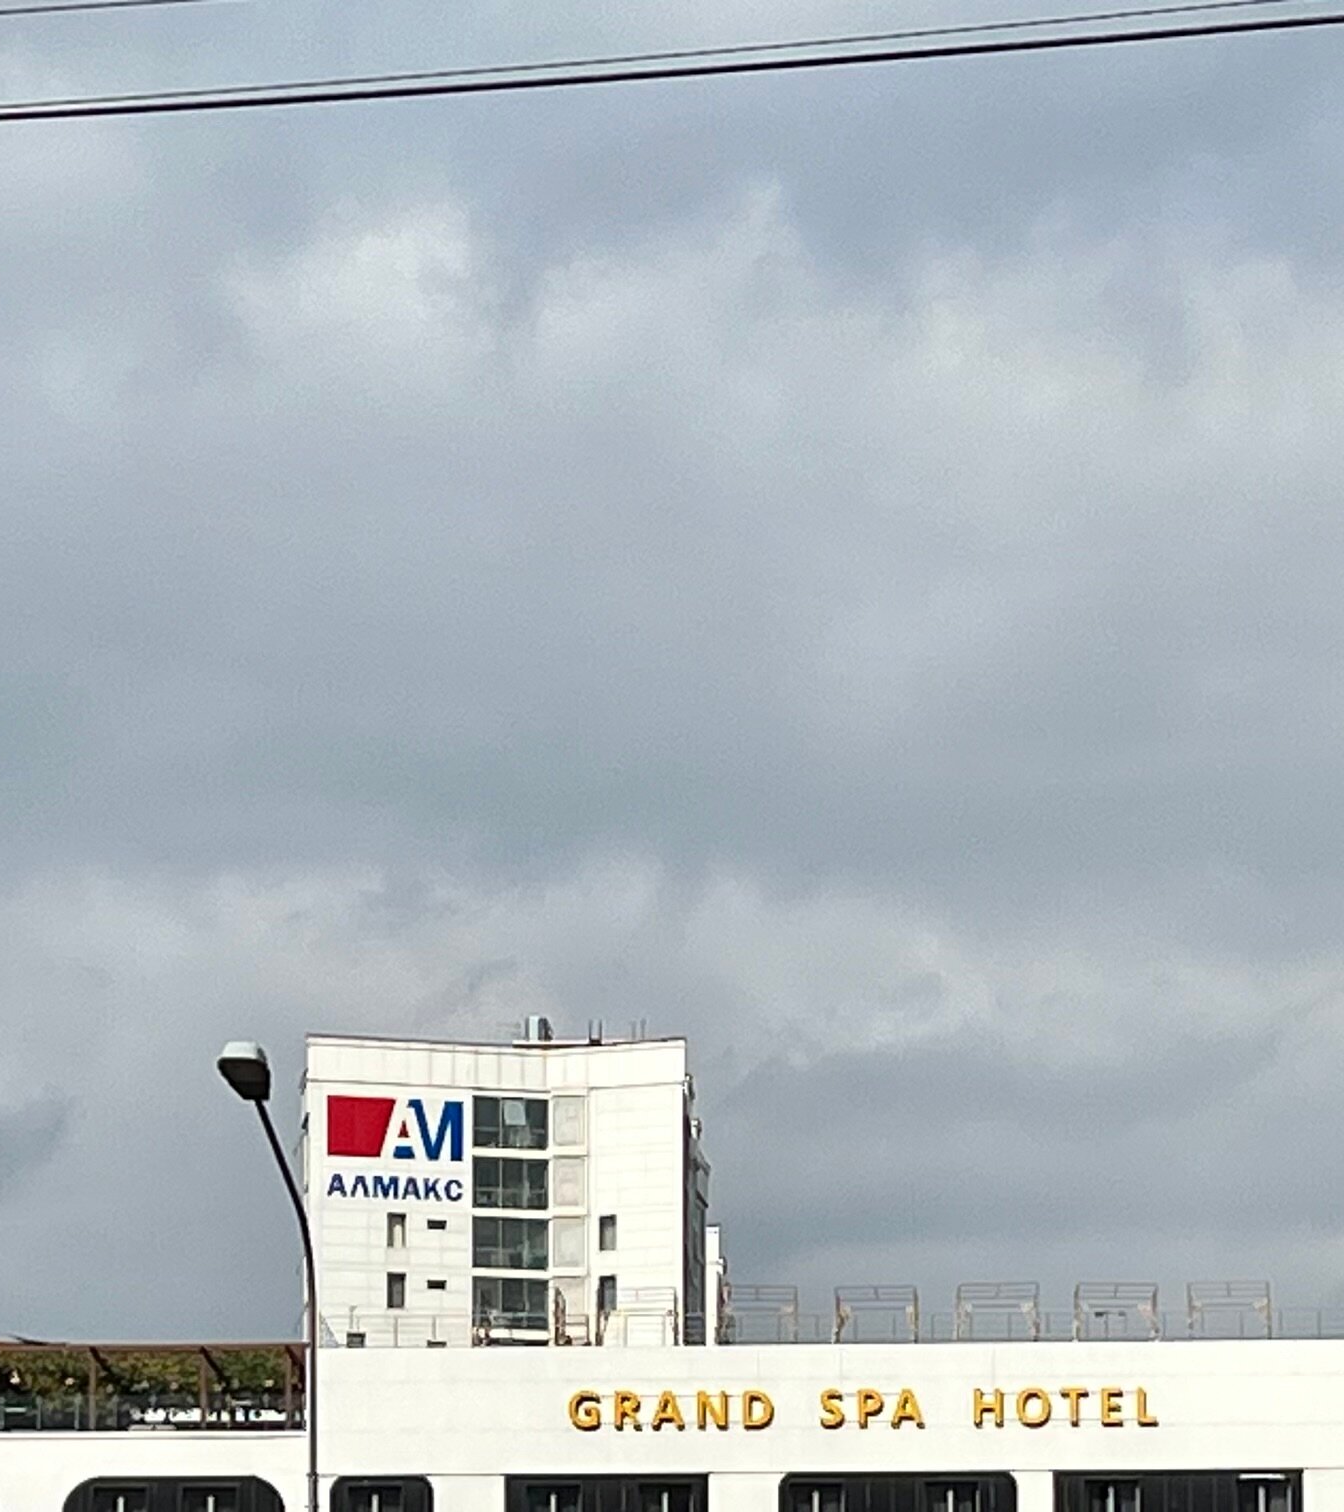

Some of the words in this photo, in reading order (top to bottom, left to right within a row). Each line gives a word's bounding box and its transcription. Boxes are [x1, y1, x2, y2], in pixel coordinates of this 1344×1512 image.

[327, 1173, 463, 1202] АЛМАКС
[568, 1390, 775, 1431] GRAND
[820, 1388, 925, 1430] SPA
[973, 1387, 1159, 1429] HOTEL
